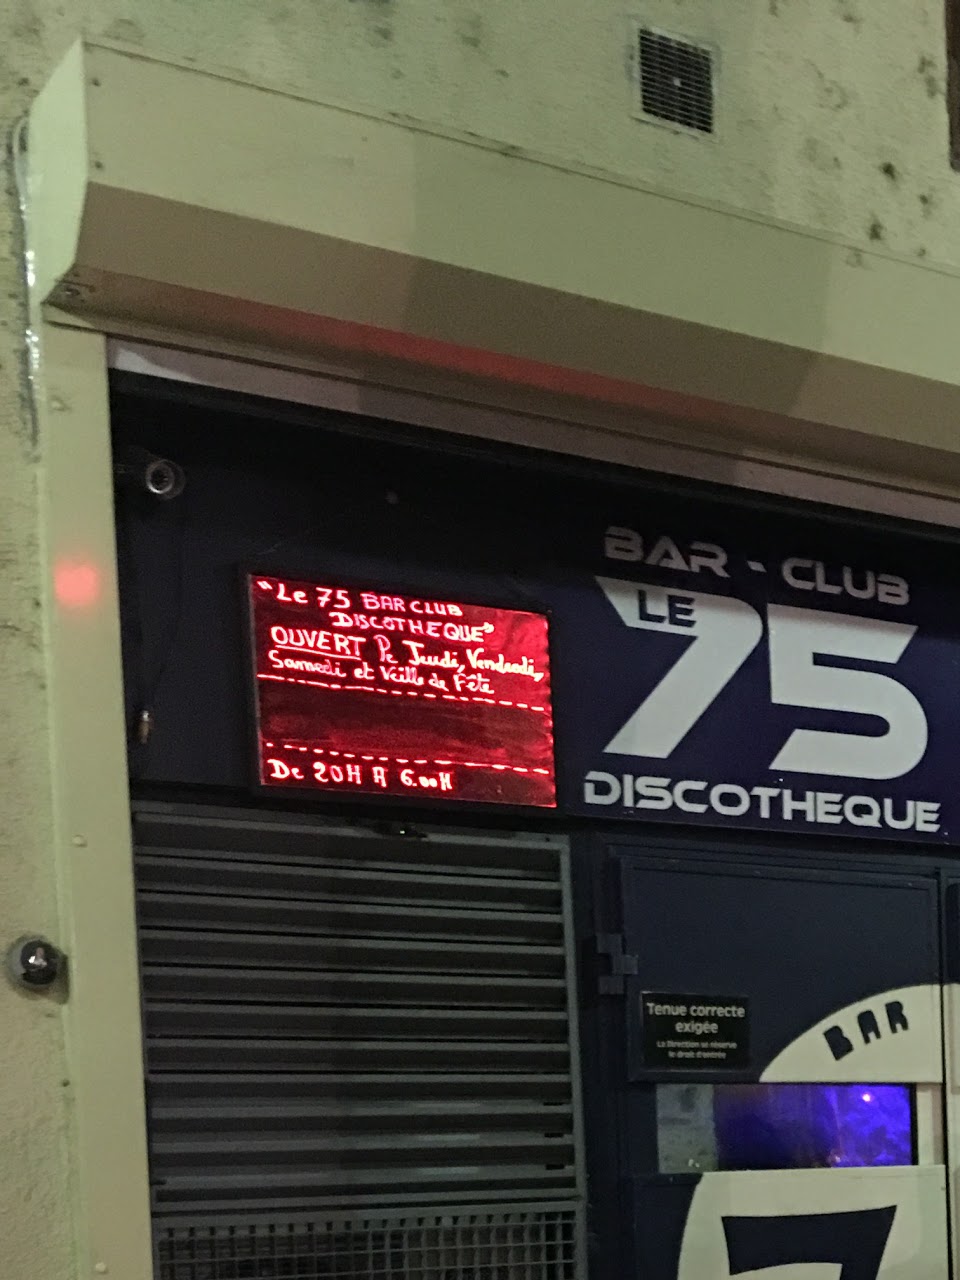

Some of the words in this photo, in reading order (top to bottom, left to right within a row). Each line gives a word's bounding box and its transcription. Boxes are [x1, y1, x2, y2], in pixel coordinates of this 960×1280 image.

[604, 526, 729, 578] BAR
[782, 557, 909, 605] CLUB
[316, 587, 350, 609] 75
[360, 592, 404, 612] BAR
[410, 601, 463, 616] CLUB
[638, 589, 697, 627] LE
[271, 626, 366, 656] OUVERT
[268, 651, 346, 677] Samedi
[354, 662, 375, 681] et
[428, 675, 449, 691] de
[595, 575, 928, 780] 75
[267, 759, 304, 780] De
[313, 762, 361, 785] 20H
[373, 766, 388, 788] A
[584, 770, 941, 832] DISCOTHEQUE
[646, 1002, 687, 1016] Tenue
[690, 1005, 746, 1018] correcte
[675, 1020, 719, 1035] exigée
[822, 1000, 910, 1061] BAR
